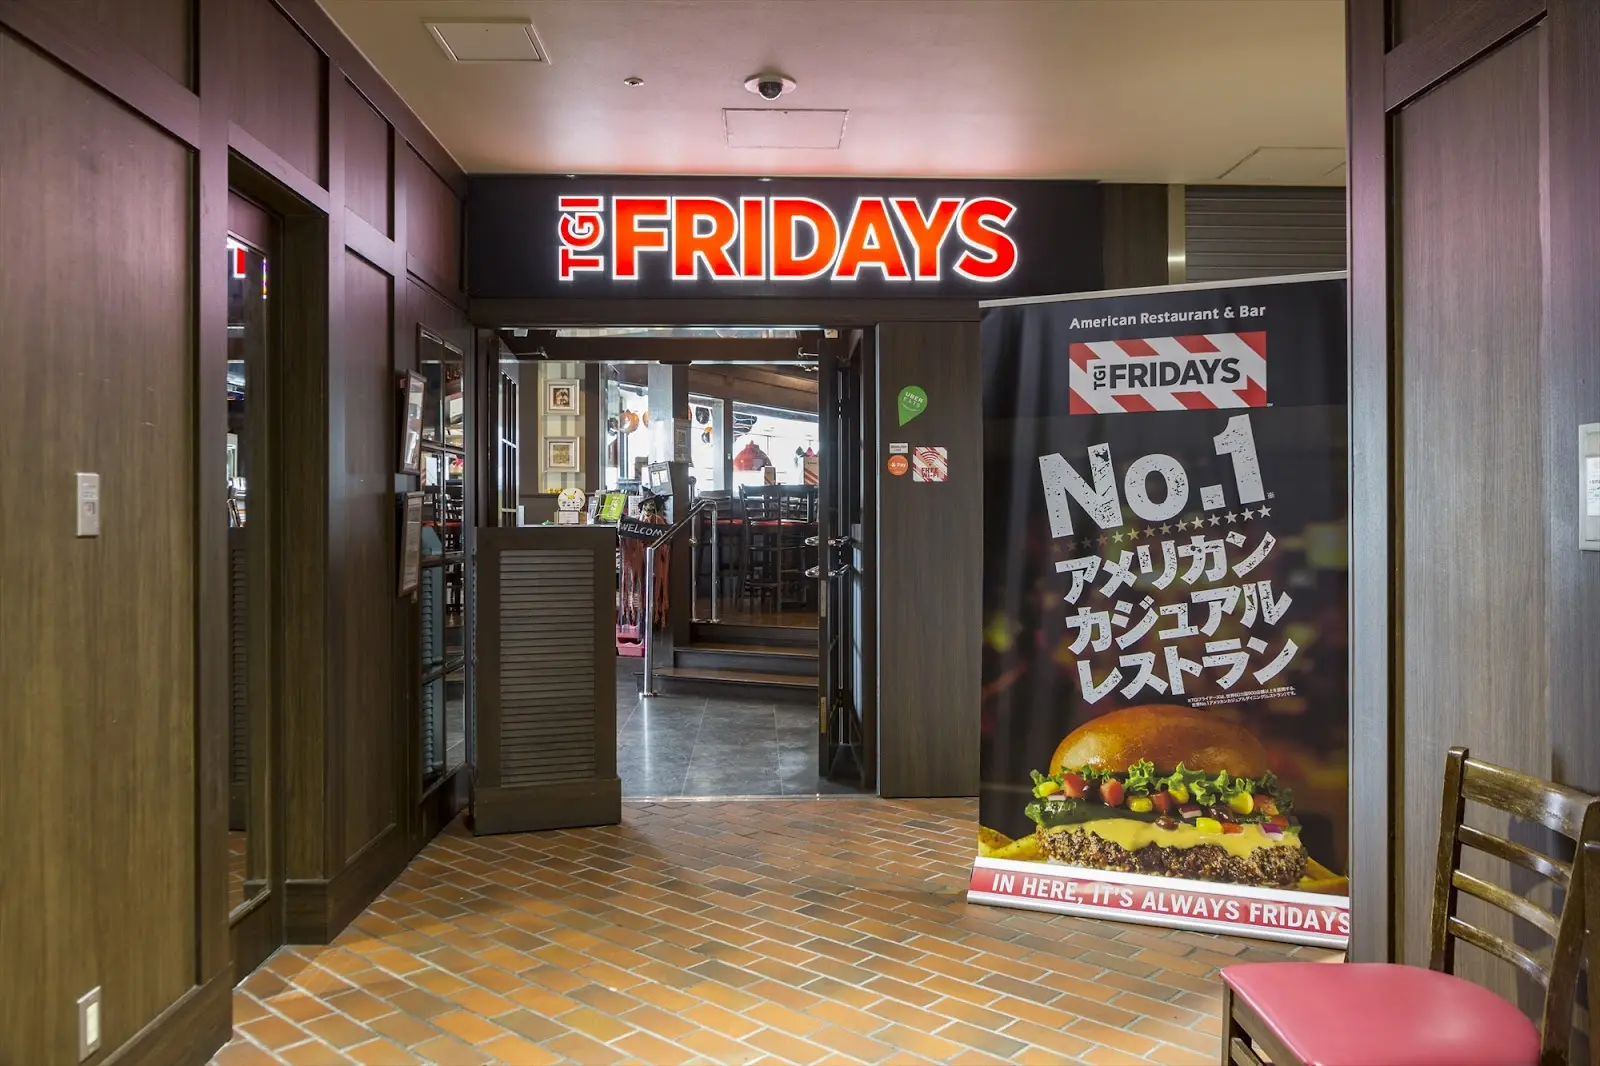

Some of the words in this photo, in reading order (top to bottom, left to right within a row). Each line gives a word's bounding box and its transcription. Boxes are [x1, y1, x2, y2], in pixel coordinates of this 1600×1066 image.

[558, 195, 605, 281] TGI
[612, 196, 1018, 282] FRIDAYS
[1069, 315, 1137, 329] American
[1140, 307, 1220, 324] Restaurant
[1223, 306, 1236, 319] &
[1239, 305, 1266, 318] Bar
[905, 391, 923, 403] UBER
[1093, 365, 1106, 390] TGI
[1109, 357, 1241, 389] FRIDAYS
[1038, 413, 1266, 538] No.1
[620, 523, 668, 537] WELCOM
[1055, 531, 1276, 605] アメリカン
[1065, 580, 1292, 655] カジュアル
[1077, 638, 1298, 705] レストラン
[991, 873, 1015, 894] IN
[1021, 876, 1084, 905] HERE,
[1092, 884, 1134, 908] IT'S
[1141, 891, 1241, 921] ALWAYS
[1249, 902, 1350, 933] FRIDAYS
